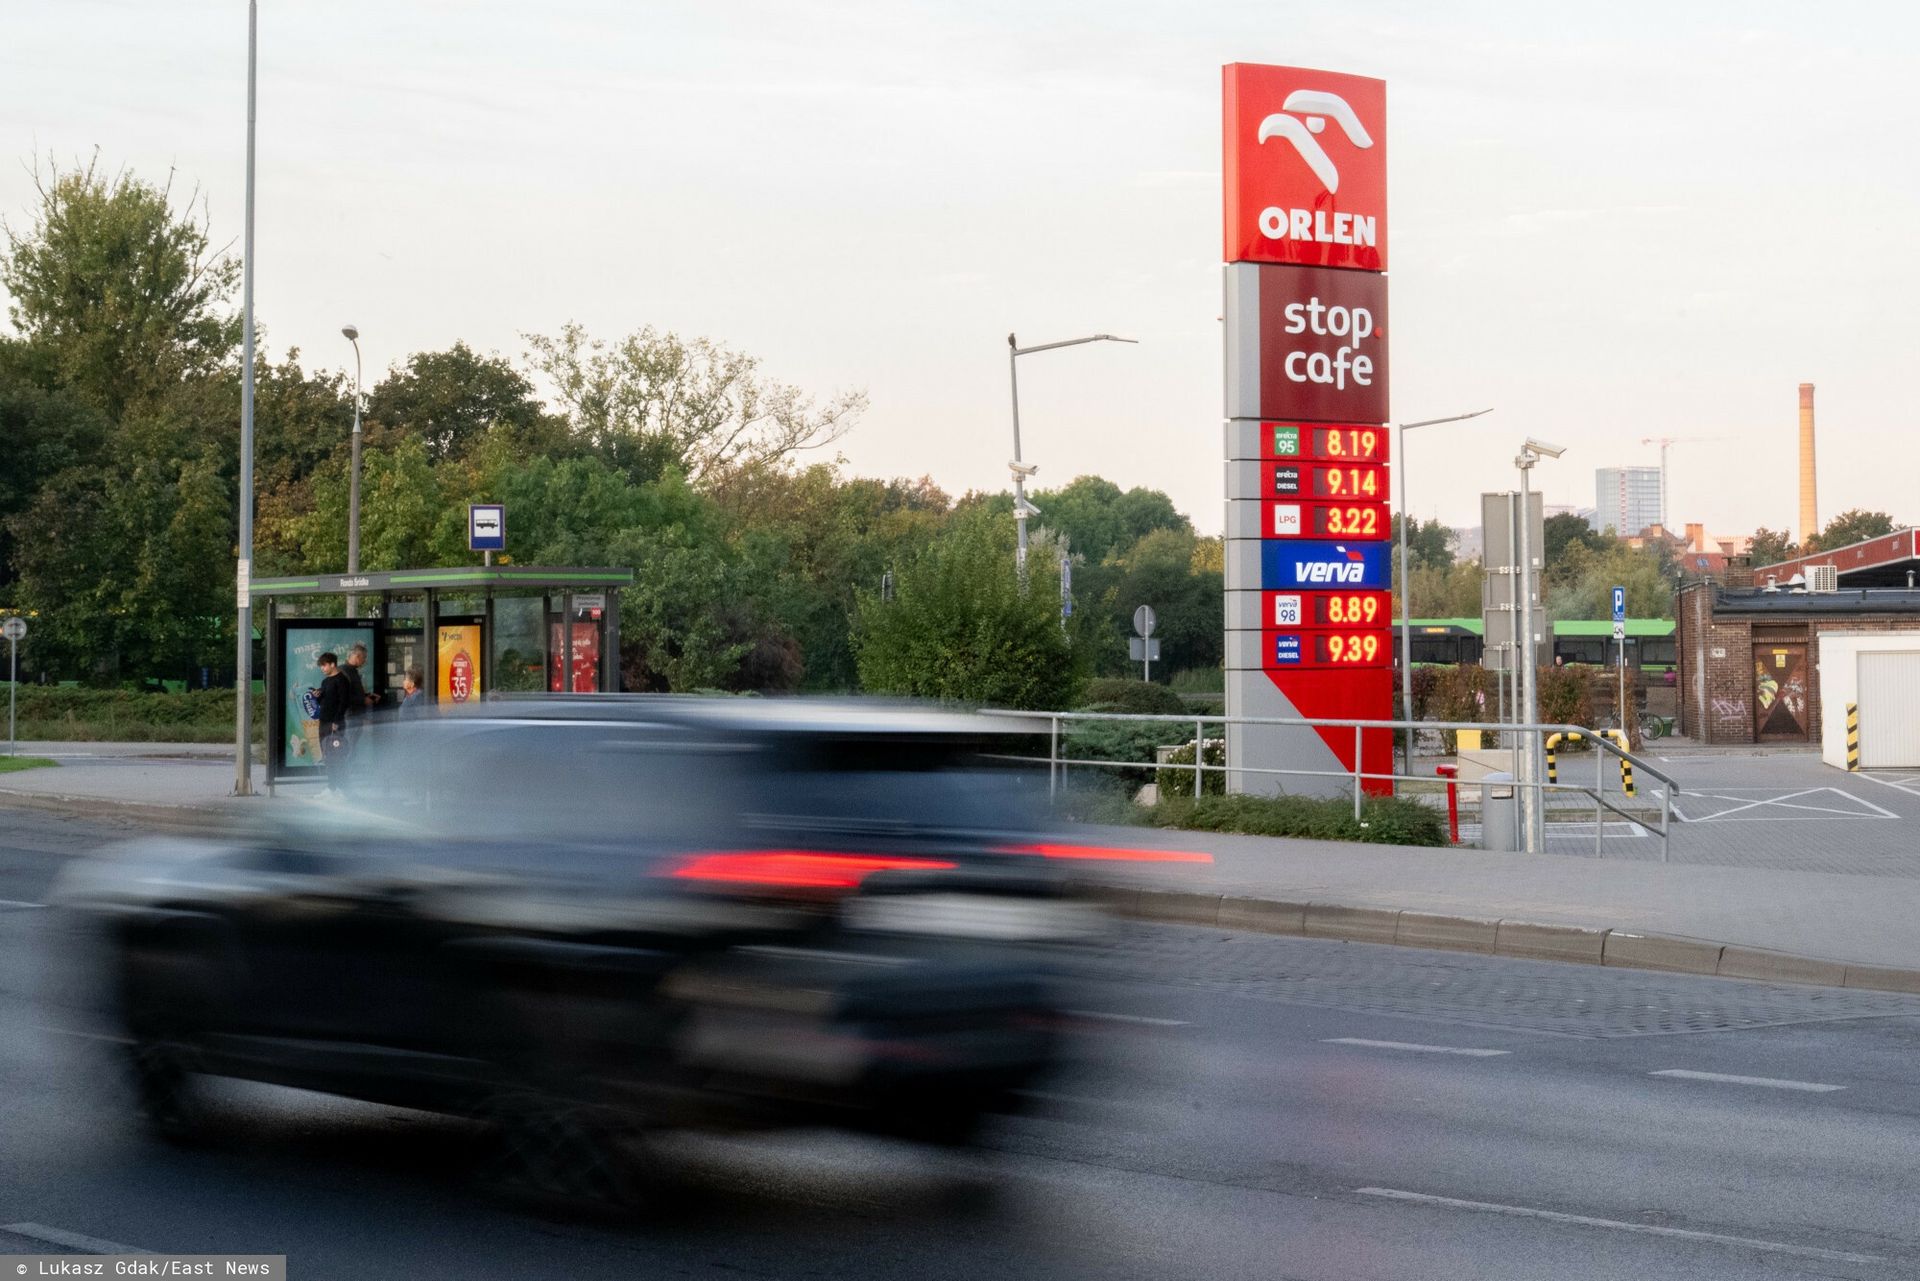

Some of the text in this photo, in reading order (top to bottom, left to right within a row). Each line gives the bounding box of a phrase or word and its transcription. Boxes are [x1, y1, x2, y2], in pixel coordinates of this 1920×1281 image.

[1258, 206, 1376, 247] ORLEN
[1284, 346, 1373, 391] cafe
[1278, 440, 1295, 453] 95
[1327, 429, 1375, 457] 8.19
[1327, 468, 1376, 496] 9.14
[1279, 515, 1297, 524] LPG
[1327, 507, 1376, 535] 3.22
[1295, 561, 1365, 583] verva
[1328, 596, 1377, 623] 8.89
[1614, 590, 1623, 612] P
[1280, 609, 1296, 622] 98
[1278, 640, 1298, 648] verva
[1328, 635, 1377, 662] 9.39
[451, 676, 467, 698] 35
